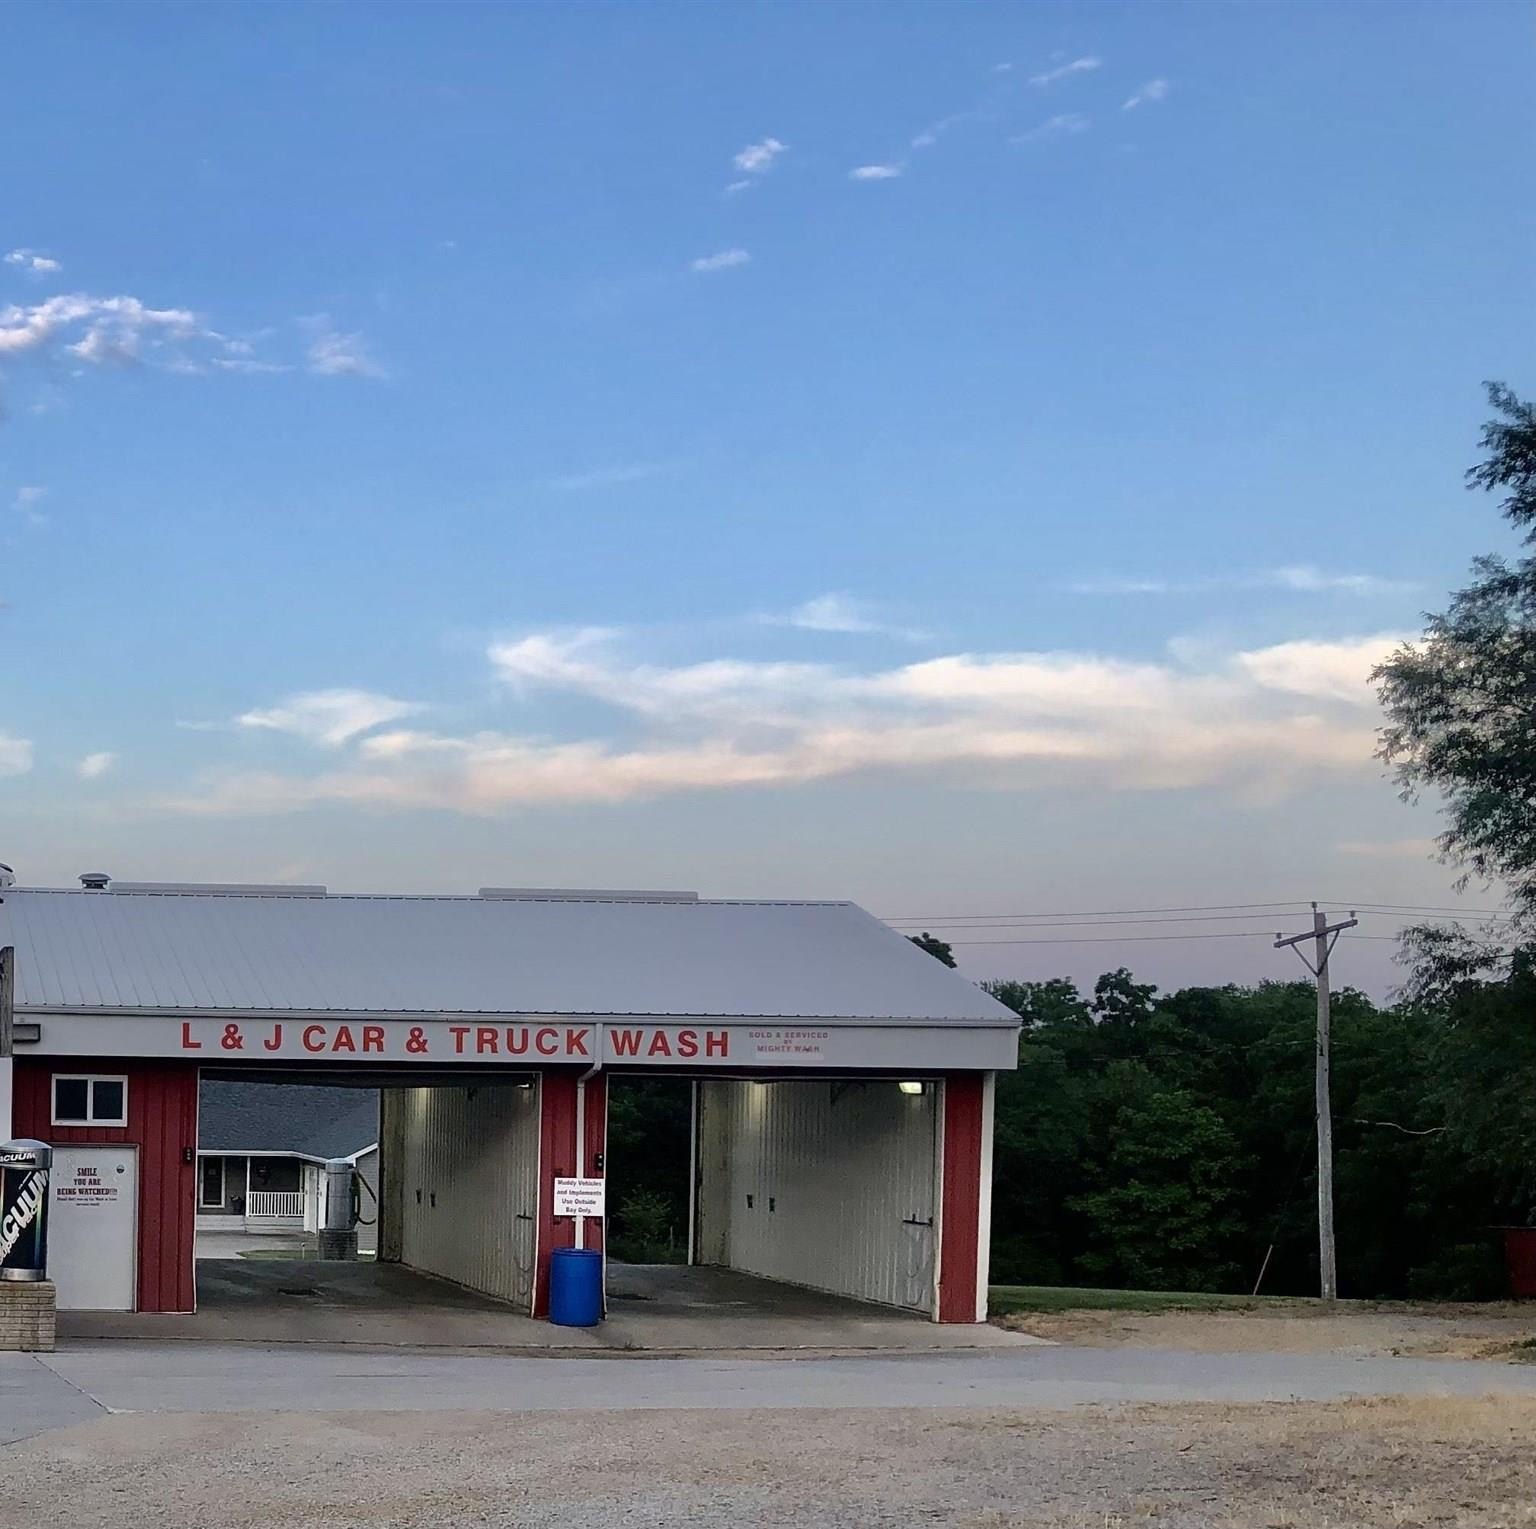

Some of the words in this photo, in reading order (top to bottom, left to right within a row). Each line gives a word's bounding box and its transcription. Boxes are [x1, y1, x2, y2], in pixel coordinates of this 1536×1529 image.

[182, 1022, 202, 1049] L
[221, 1023, 243, 1050] &
[264, 1024, 282, 1051] J
[302, 1025, 385, 1053] CAR
[405, 1027, 428, 1053] &
[449, 1027, 589, 1056] TRUCK
[610, 1030, 729, 1058] WASH
[756, 1045, 792, 1053] MIGHTY
[76, 1167, 98, 1177] SMILE
[73, 1178, 87, 1186] YOU
[88, 1178, 102, 1186] ARE
[56, 1188, 77, 1196] BEING
